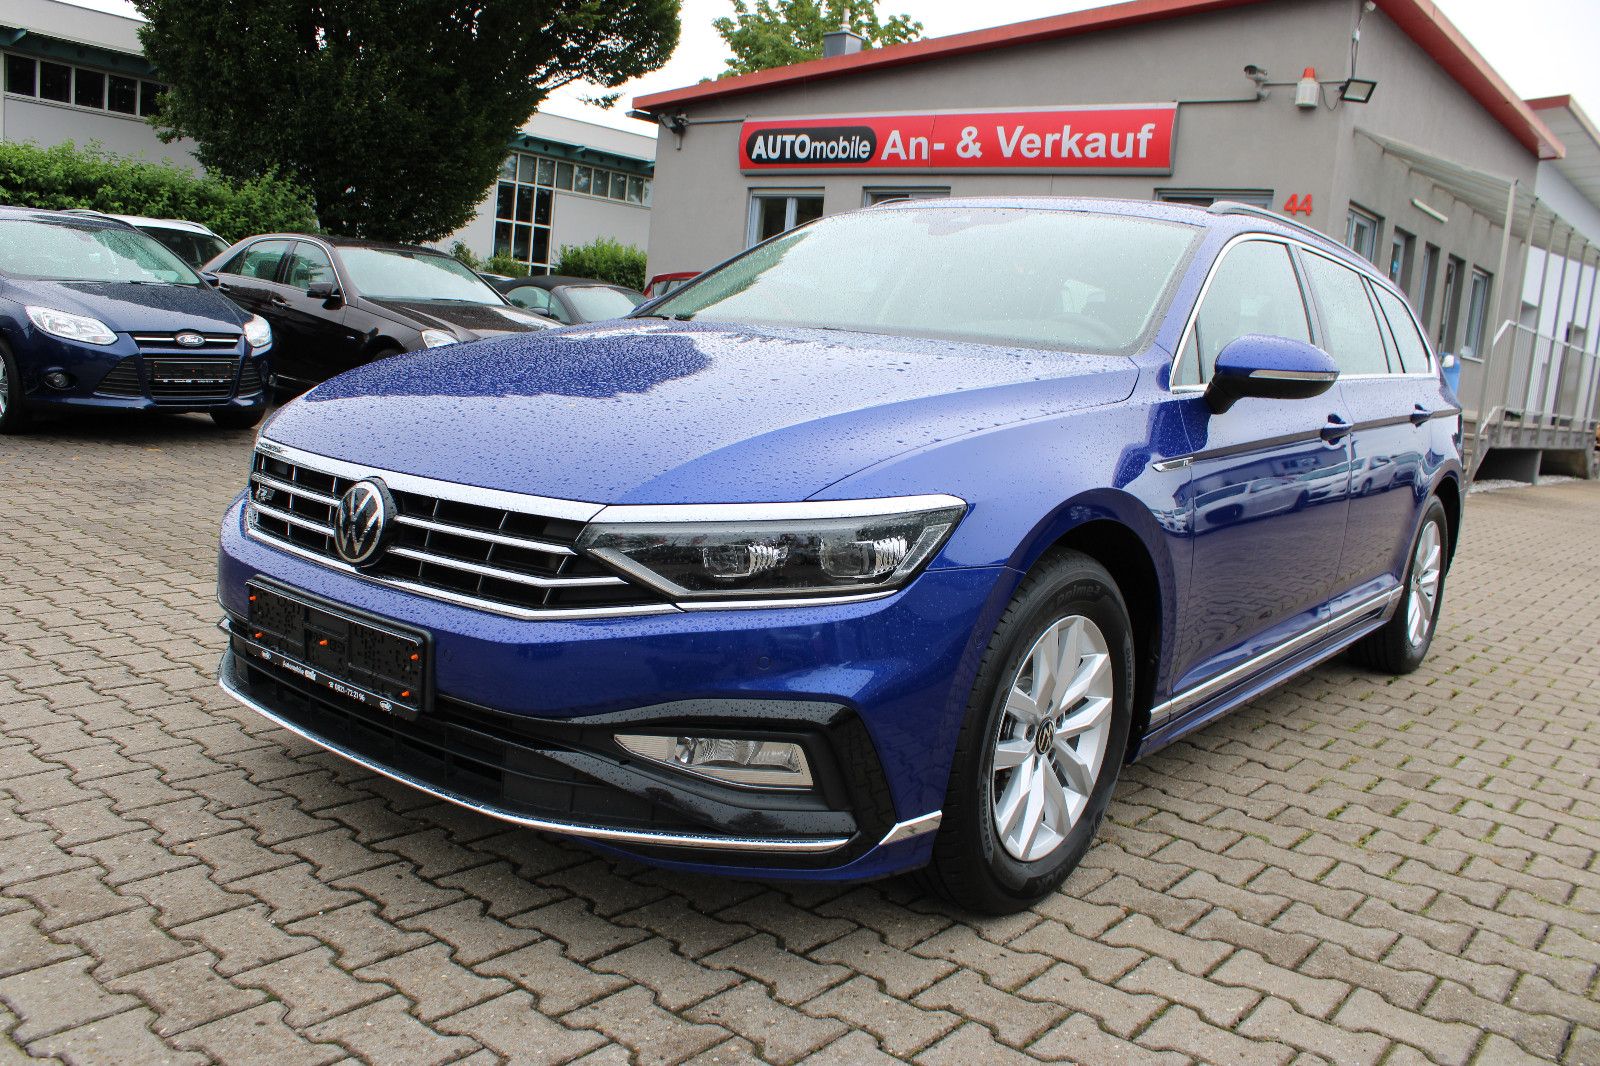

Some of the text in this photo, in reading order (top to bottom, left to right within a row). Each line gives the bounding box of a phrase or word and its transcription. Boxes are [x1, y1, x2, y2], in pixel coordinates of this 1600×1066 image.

[751, 123, 1155, 161] AUTOmobile An- & Verkauf
[1284, 193, 1313, 216] 44
